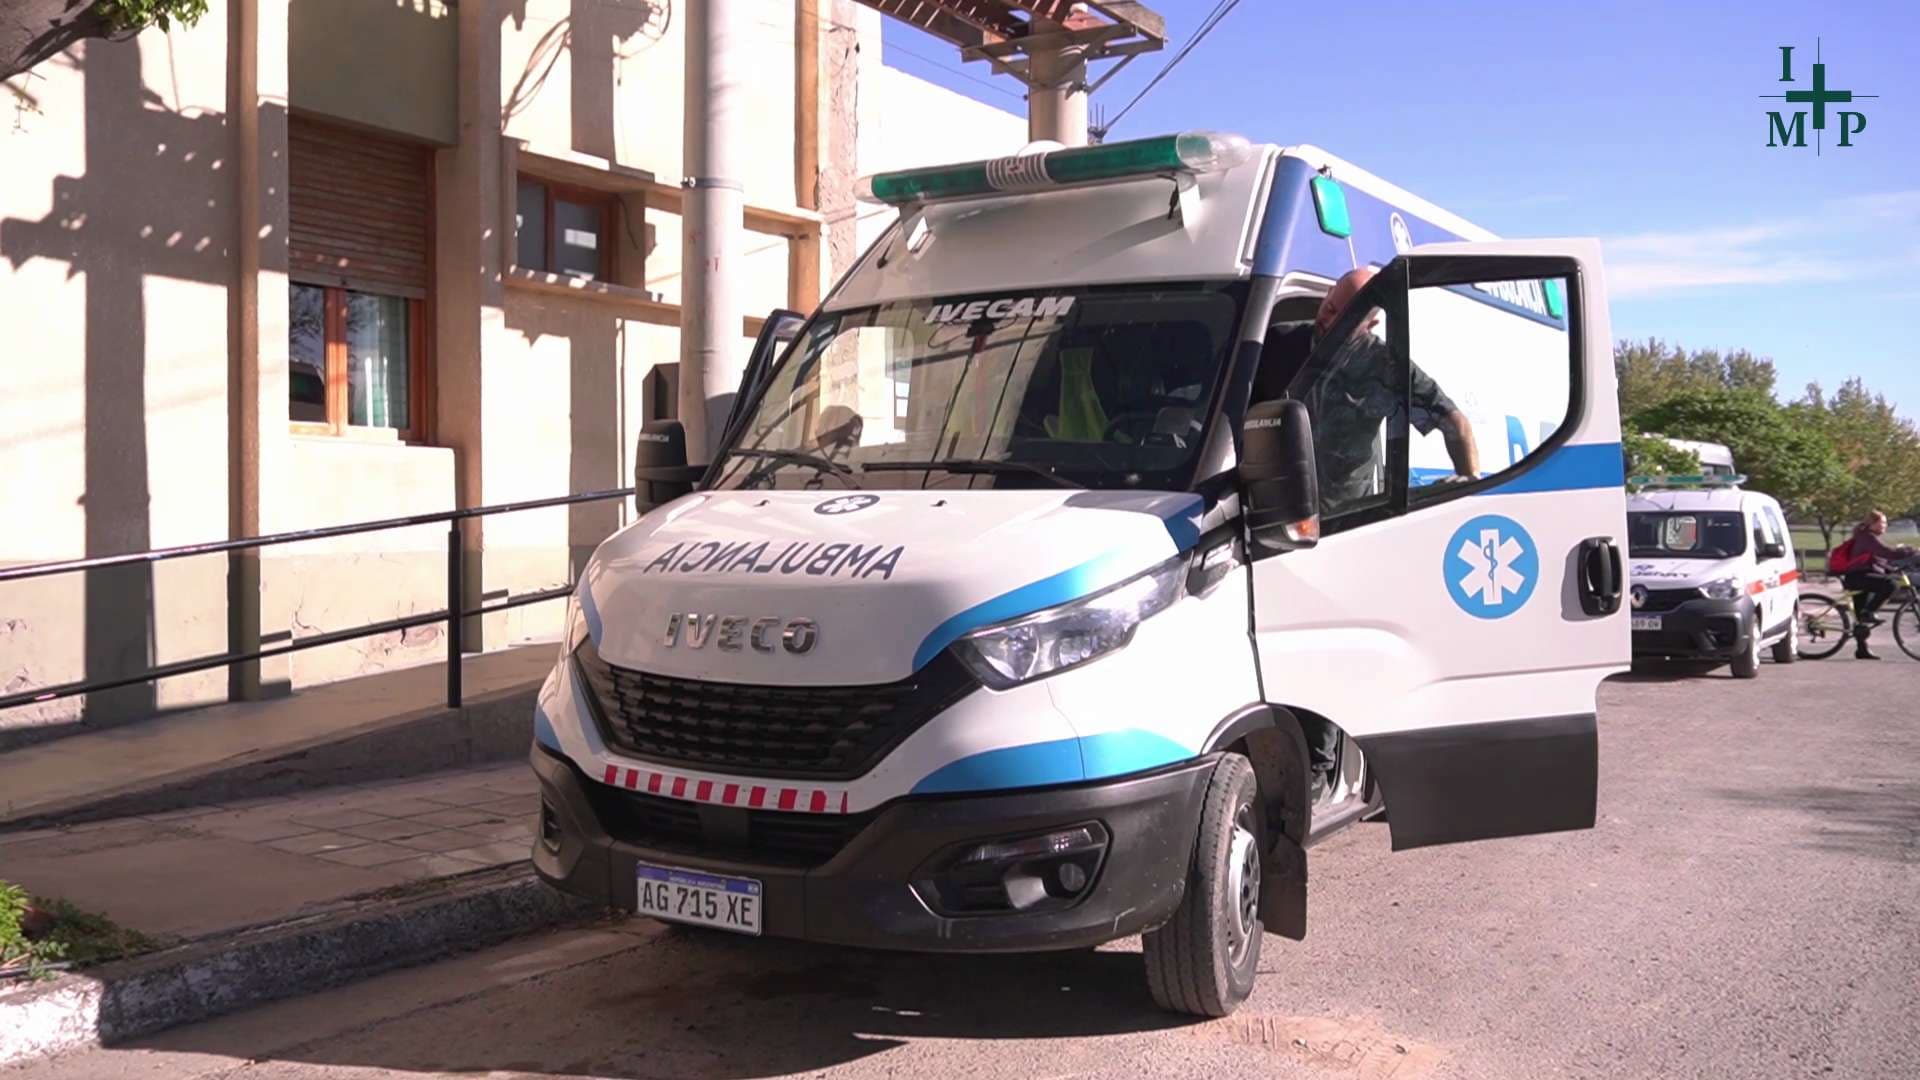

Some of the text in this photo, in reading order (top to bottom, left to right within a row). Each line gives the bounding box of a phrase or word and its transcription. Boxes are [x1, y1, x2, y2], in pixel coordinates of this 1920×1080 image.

[925, 296, 1076, 324] IVECAM
[1243, 418, 1281, 430] ULANCIA
[663, 612, 819, 655] IVECO
[642, 881, 669, 912] AG
[676, 886, 718, 920] 715
[726, 894, 753, 927] XE
